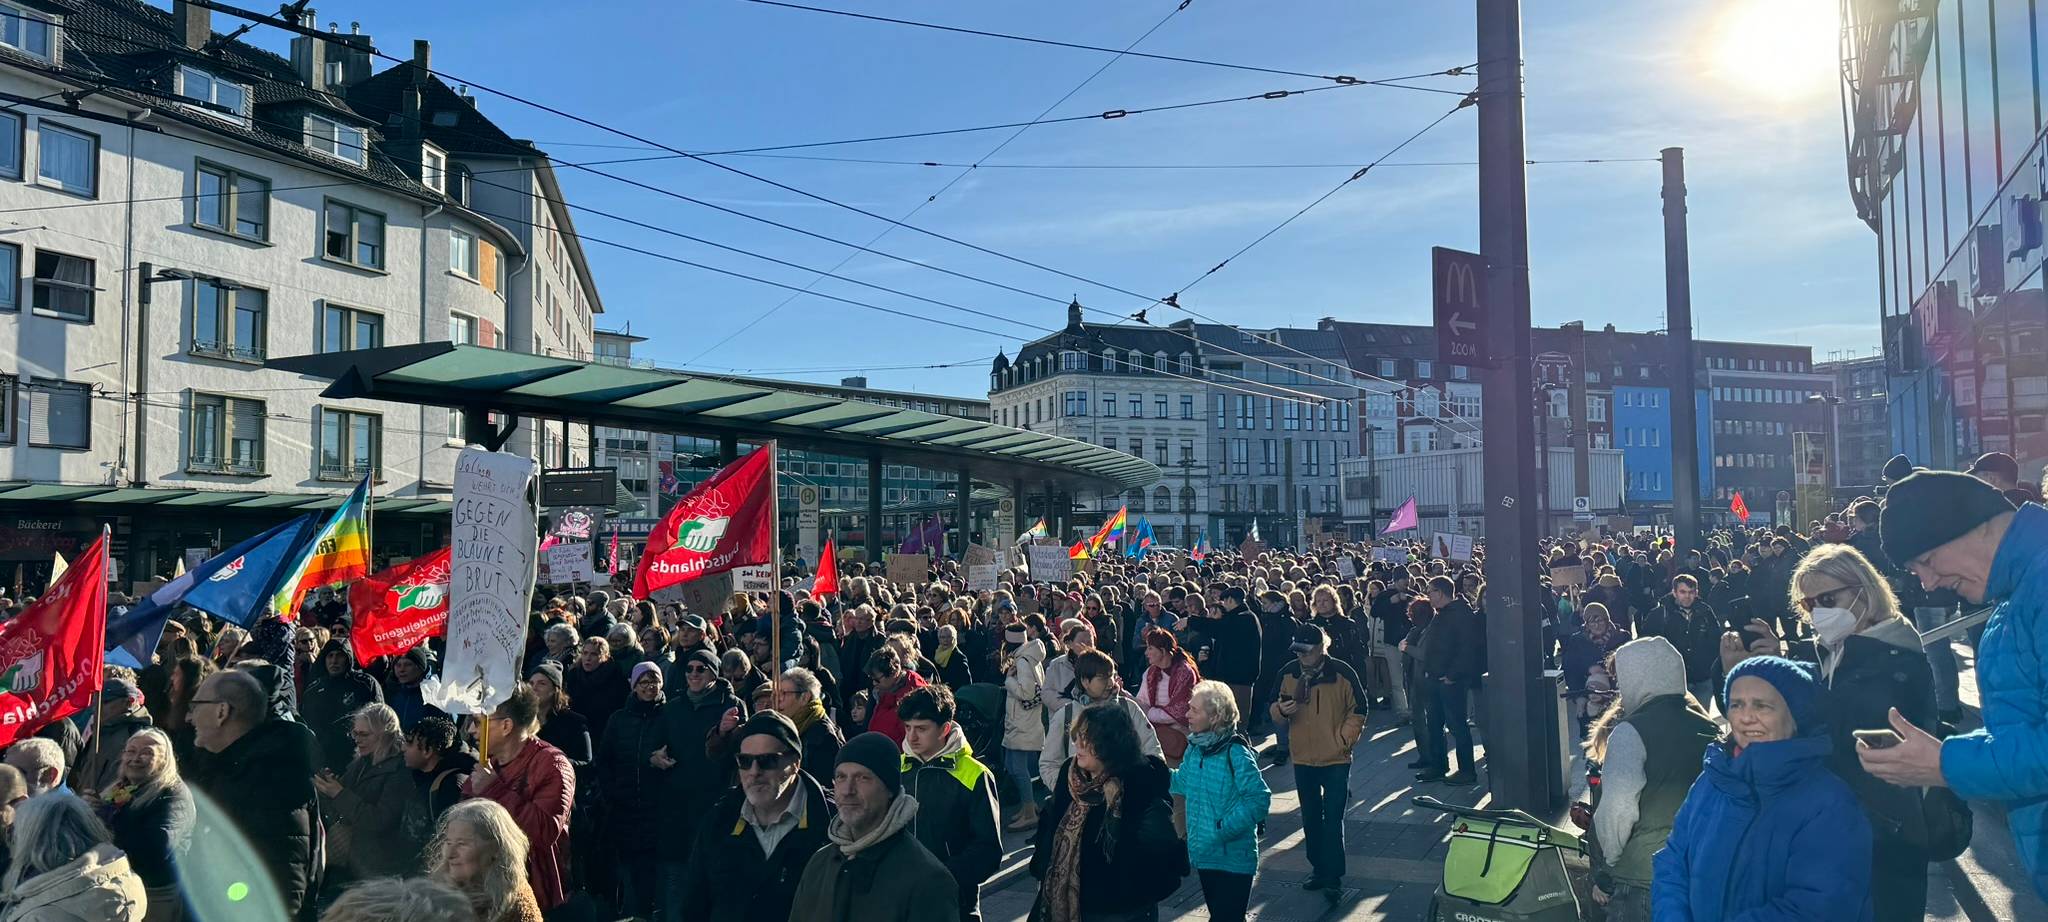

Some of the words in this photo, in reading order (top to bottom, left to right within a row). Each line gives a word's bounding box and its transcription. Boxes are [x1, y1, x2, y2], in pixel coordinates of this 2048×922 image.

[17, 519, 62, 531] Bäckerei
[455, 498, 512, 527] GEGEN
[471, 525, 489, 541] DIE
[457, 539, 505, 564] BLAUNE
[465, 566, 503, 596] BRUT
